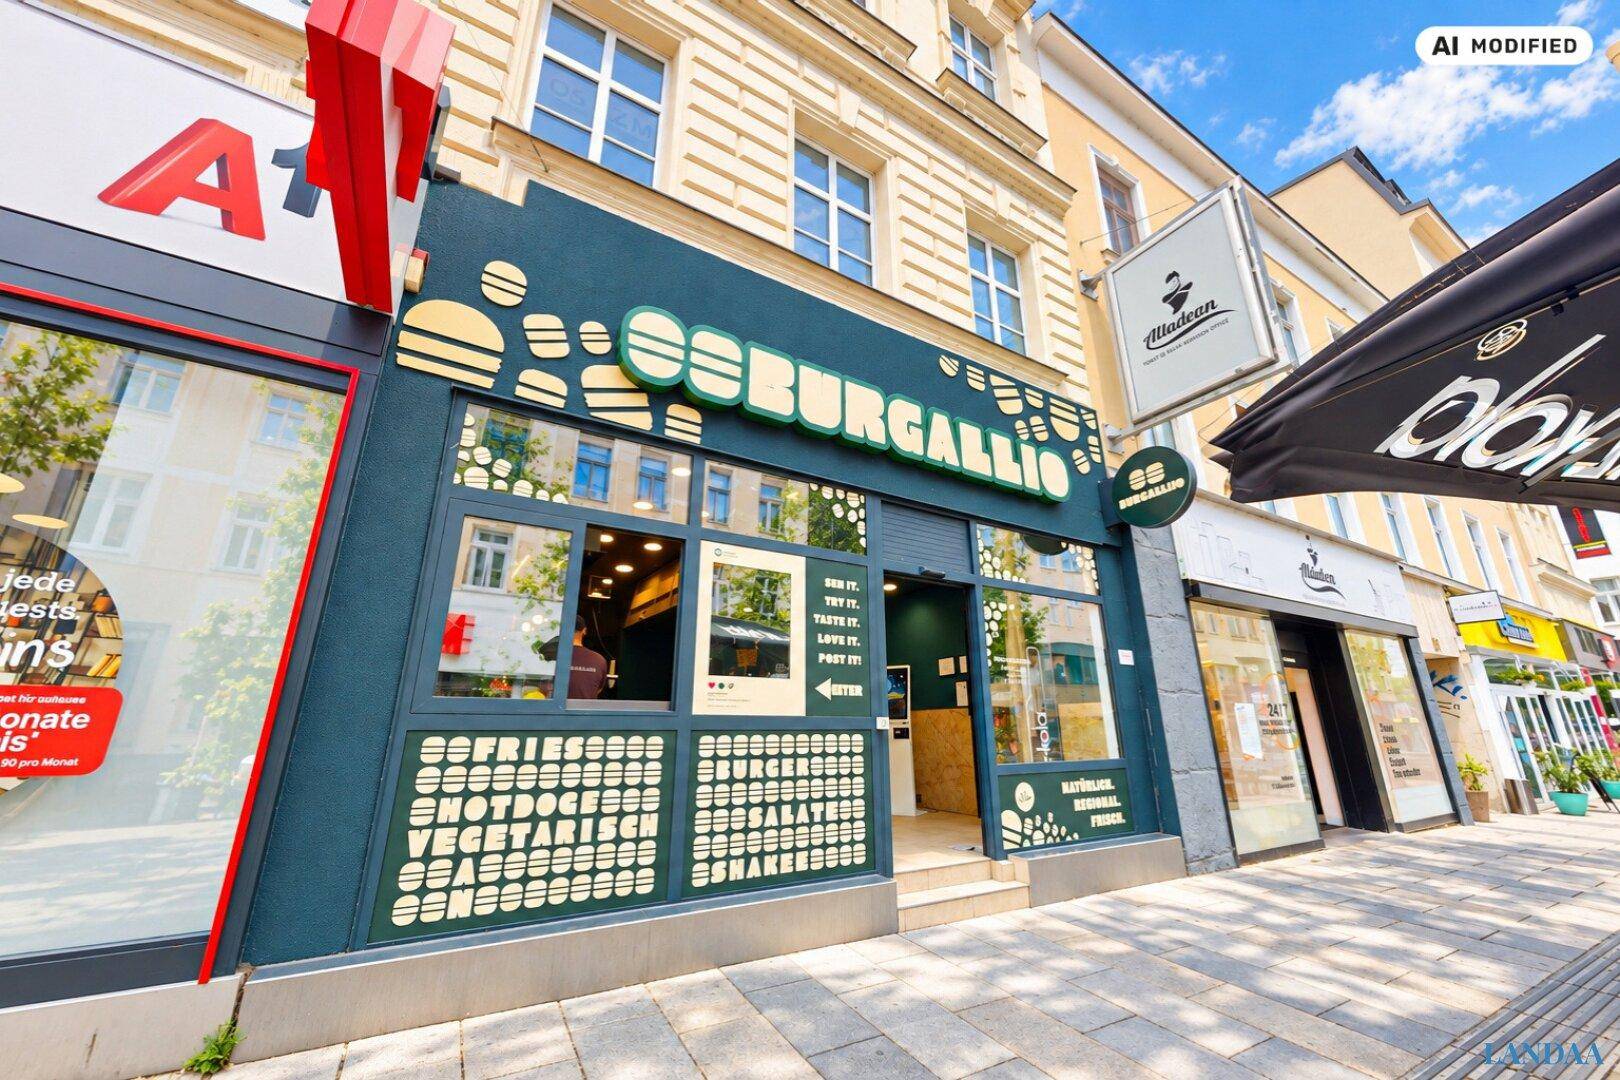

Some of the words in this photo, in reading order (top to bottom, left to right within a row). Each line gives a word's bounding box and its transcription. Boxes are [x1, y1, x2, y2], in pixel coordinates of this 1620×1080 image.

[747, 344, 1070, 500] BURGALLIO
[0, 568, 76, 593] jede
[847, 580, 860, 591] IT.
[824, 596, 845, 608] TRY
[847, 598, 860, 609] IT.
[813, 613, 846, 626] TASTE
[847, 617, 860, 628] IT.
[817, 633, 845, 646] LOVE
[847, 635, 861, 647] IT.
[818, 653, 846, 664] POST
[472, 736, 585, 762] FRIES
[18, 759, 39, 769] pro
[41, 757, 79, 767] Monat
[715, 757, 810, 781] BURGER
[748, 801, 839, 829] SALATE
[407, 813, 659, 858] VEGETARISCH
